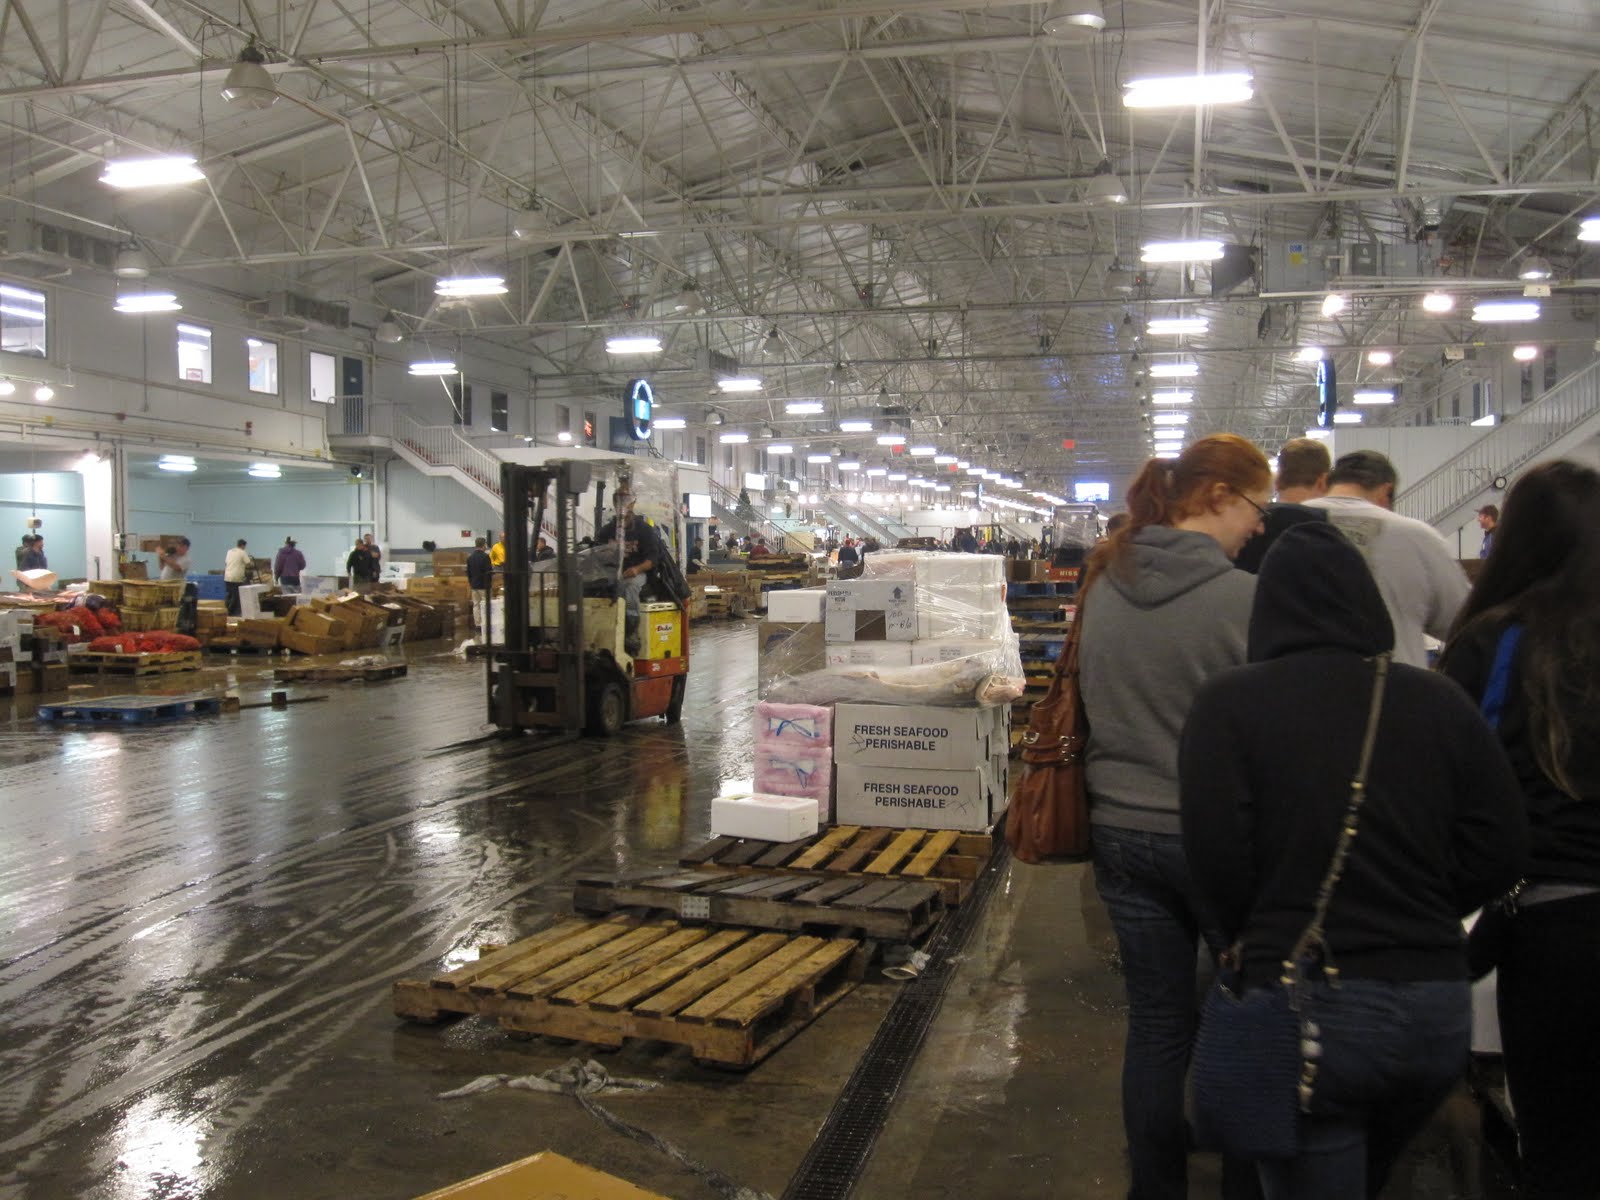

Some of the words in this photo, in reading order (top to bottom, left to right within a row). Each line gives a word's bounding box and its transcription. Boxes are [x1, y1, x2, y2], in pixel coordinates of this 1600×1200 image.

[565, 498, 574, 554] NISSAN
[854, 724, 891, 736] FRESH
[893, 726, 949, 738] SEAFOOD
[865, 738, 936, 751] PERISHABLE
[863, 782, 900, 794] FRESH
[903, 784, 959, 796] SEAFOOD
[875, 796, 946, 809] PERISHABLE
